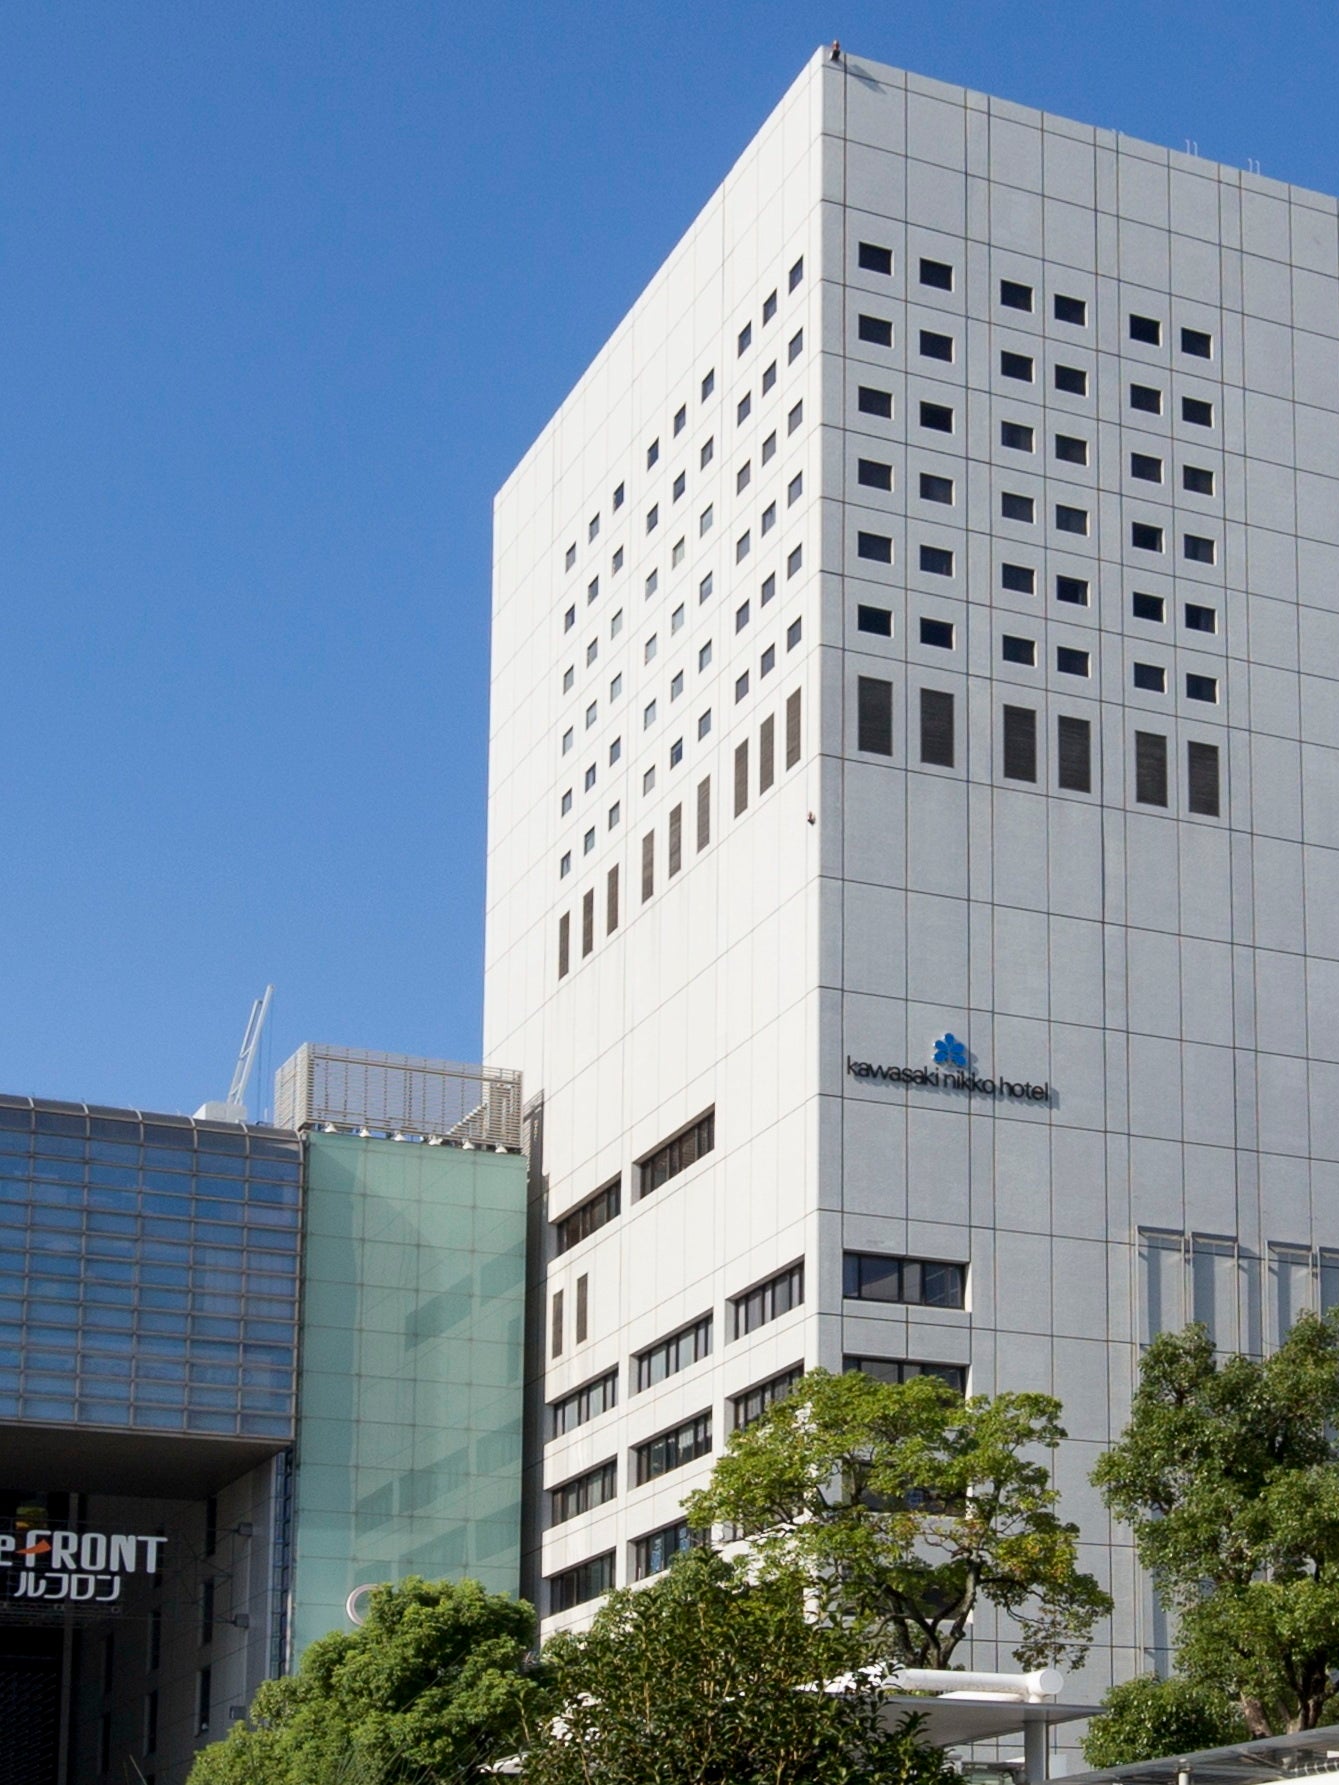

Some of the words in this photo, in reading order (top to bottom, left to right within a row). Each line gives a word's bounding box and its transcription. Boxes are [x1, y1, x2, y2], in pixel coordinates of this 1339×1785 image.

[847, 1055, 939, 1087] kawasaki
[944, 1070, 996, 1094] nikko
[1000, 1076, 1049, 1101] hotel
[14, 1571, 121, 1601] ルフロン
